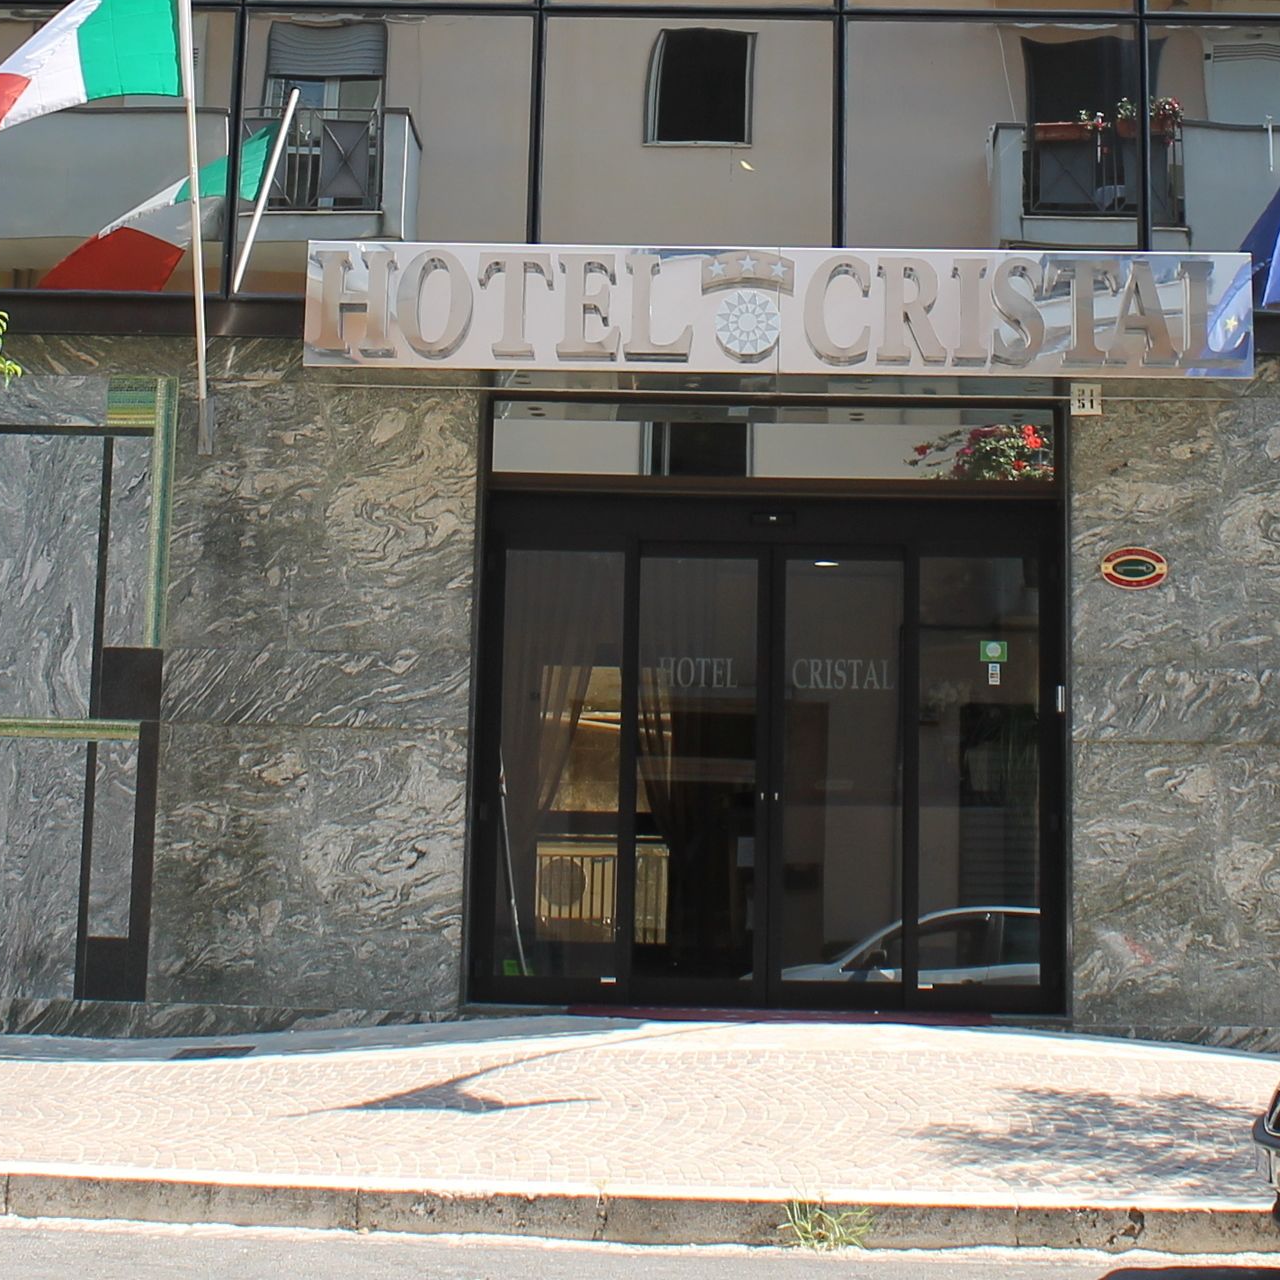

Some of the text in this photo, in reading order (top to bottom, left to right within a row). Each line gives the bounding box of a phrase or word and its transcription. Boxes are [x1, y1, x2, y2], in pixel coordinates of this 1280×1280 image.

[310, 249, 1250, 367] HOTEL CRISTAL
[658, 657, 895, 690] HOTEL CRISTAL
